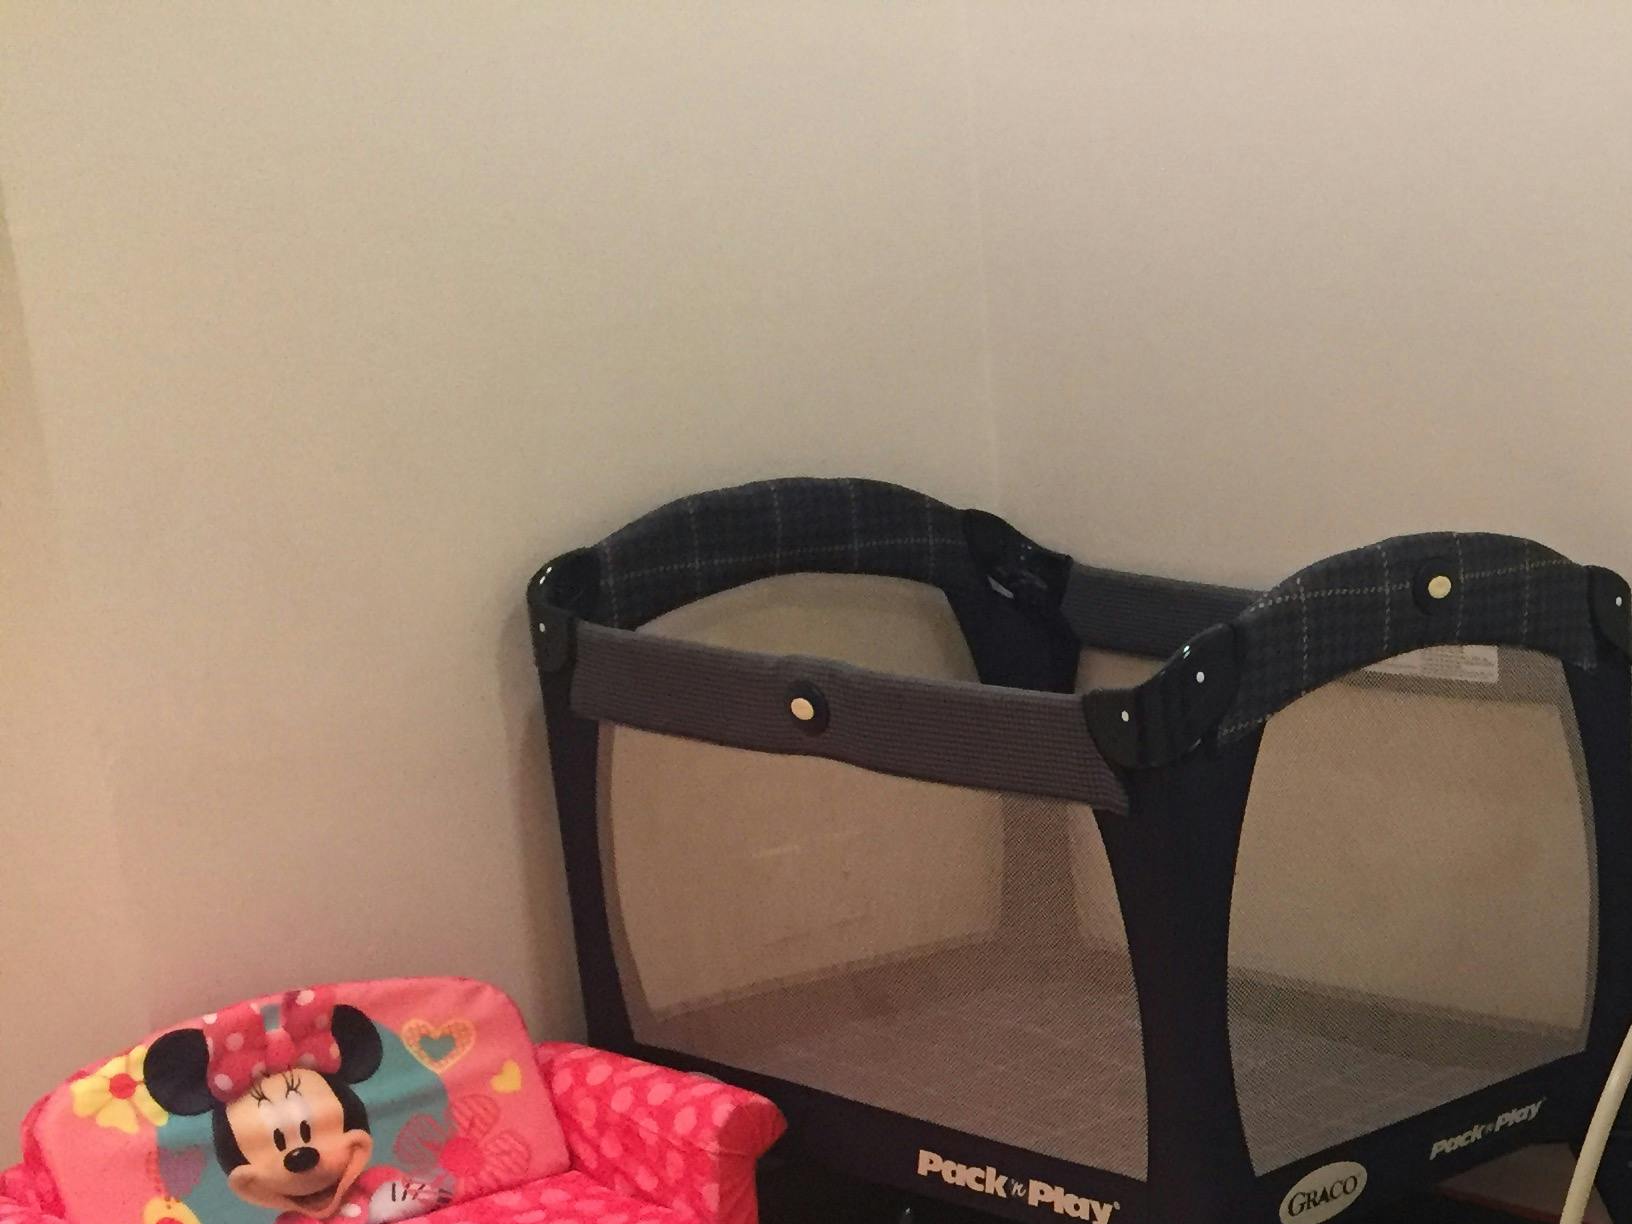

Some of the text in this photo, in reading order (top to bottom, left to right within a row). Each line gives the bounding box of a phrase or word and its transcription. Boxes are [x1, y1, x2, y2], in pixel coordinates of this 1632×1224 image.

[1494, 1100, 1543, 1132] Play
[917, 1149, 1008, 1199] Pack
[1287, 1174, 1358, 1217] GRACO
